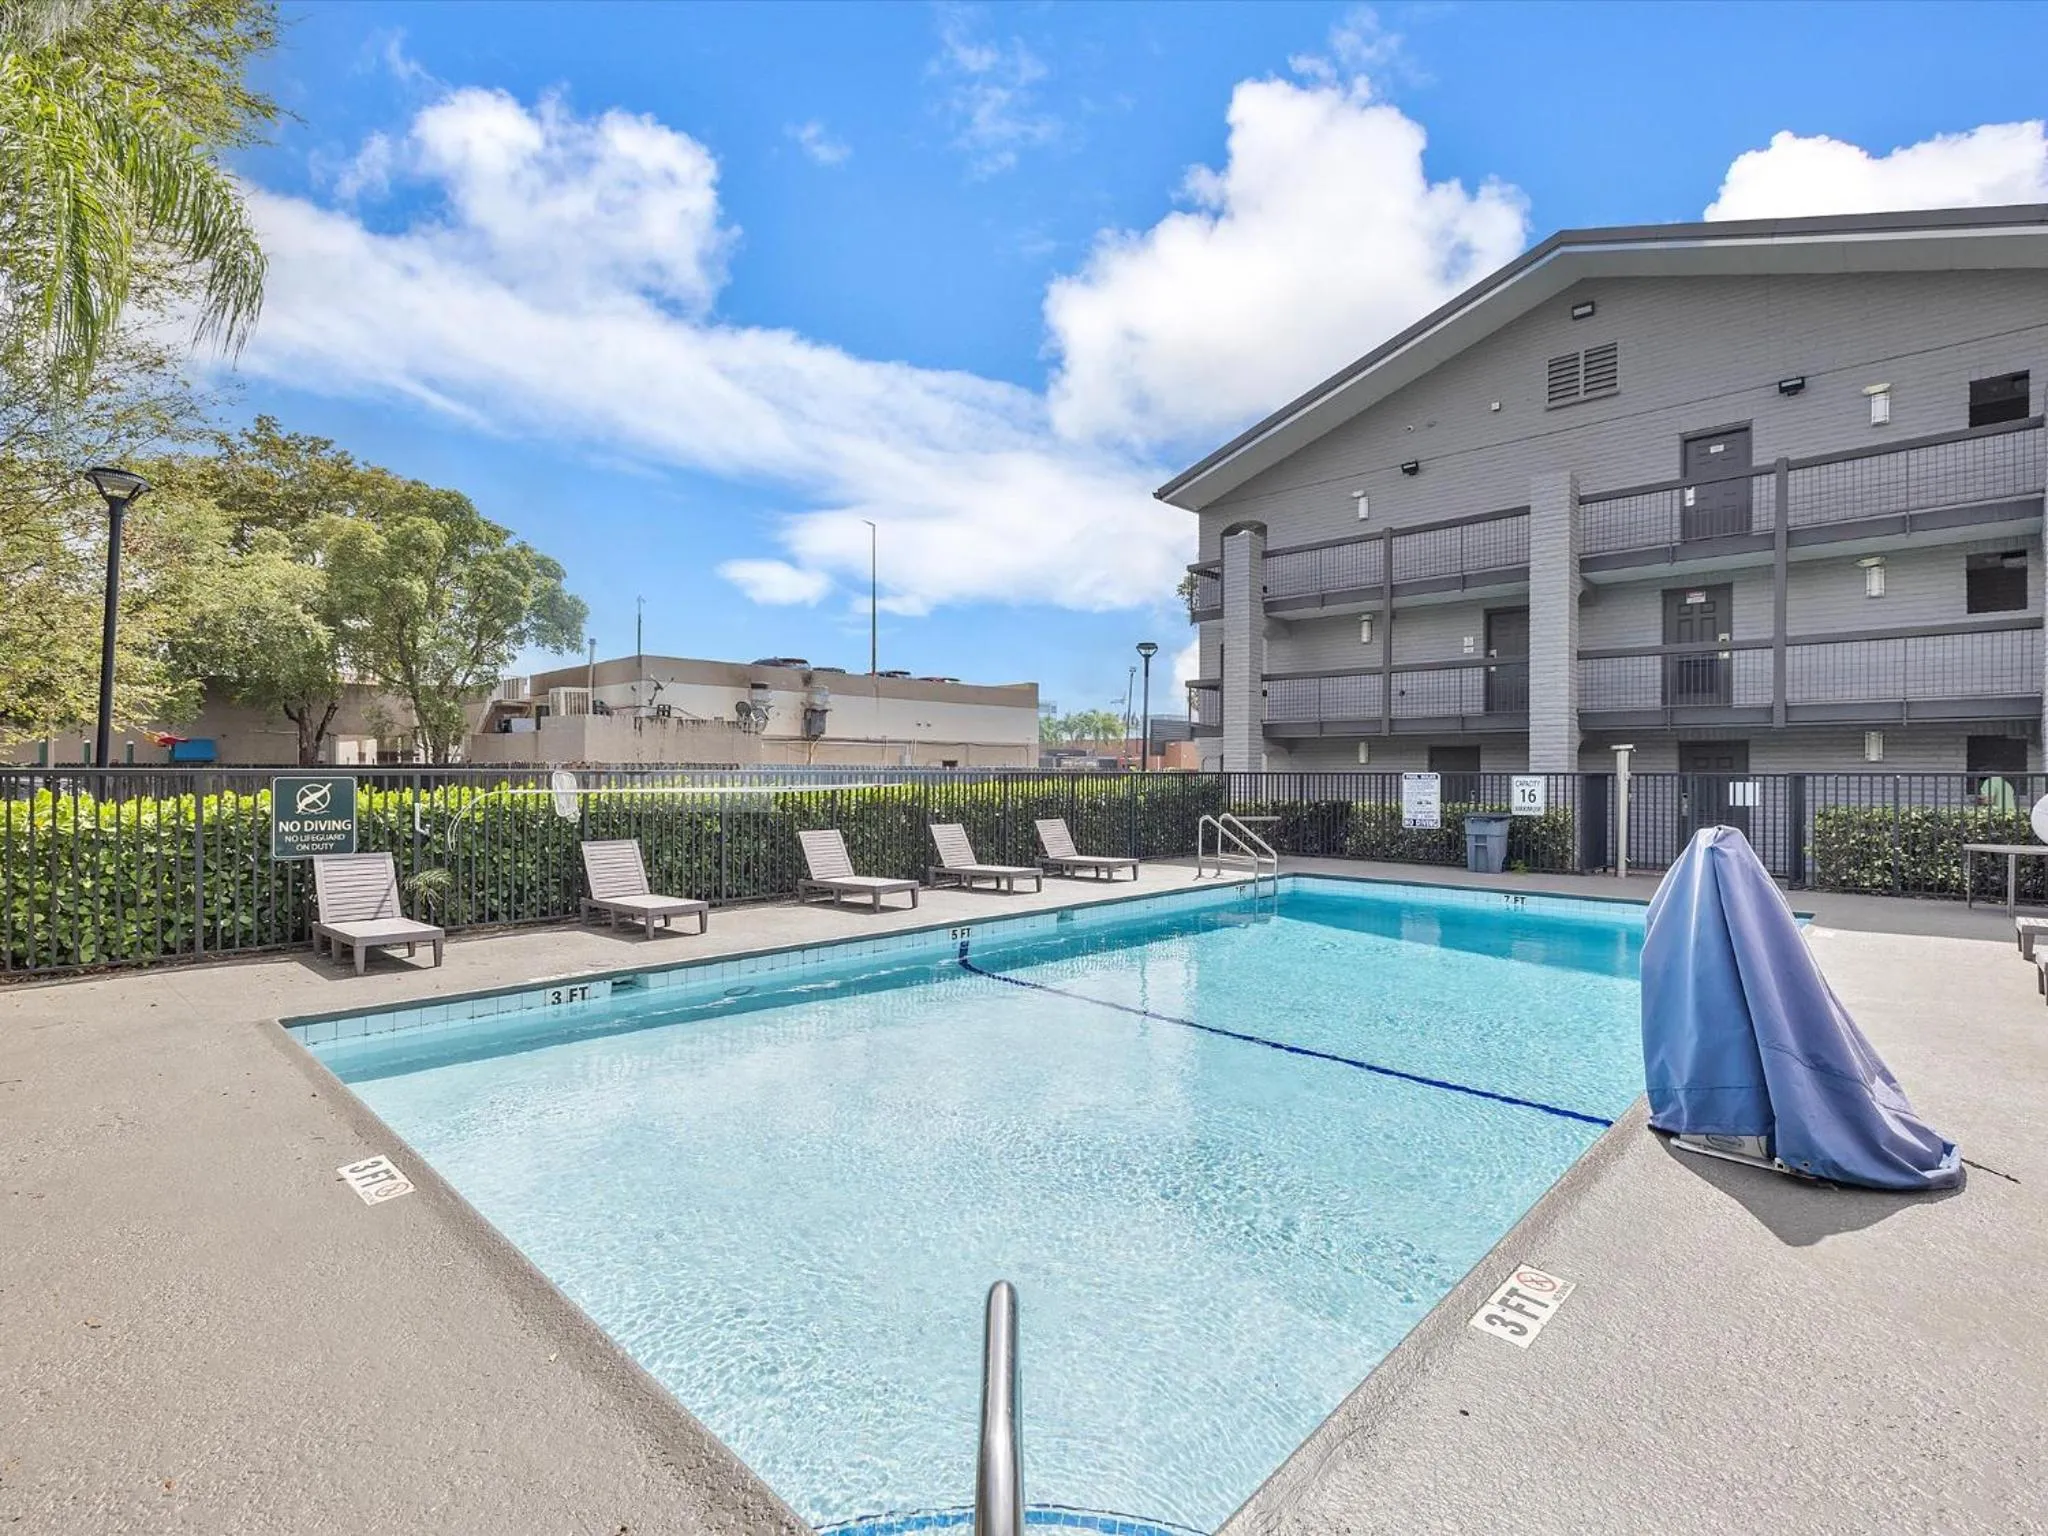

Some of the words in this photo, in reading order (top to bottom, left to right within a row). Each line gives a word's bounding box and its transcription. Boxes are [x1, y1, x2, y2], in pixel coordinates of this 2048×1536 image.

[1520, 789, 1537, 804] 16
[279, 820, 301, 833] NO
[303, 819, 352, 832] DIVING
[284, 834, 299, 843] NO
[300, 833, 346, 842] LIFEGUARD
[296, 843, 310, 851] ON
[311, 842, 335, 851] DUTY
[960, 927, 971, 939] FT
[551, 990, 562, 1006] 3
[568, 986, 589, 1003] FT
[1497, 1286, 1550, 1321] FT
[1484, 1313, 1529, 1336] 3
